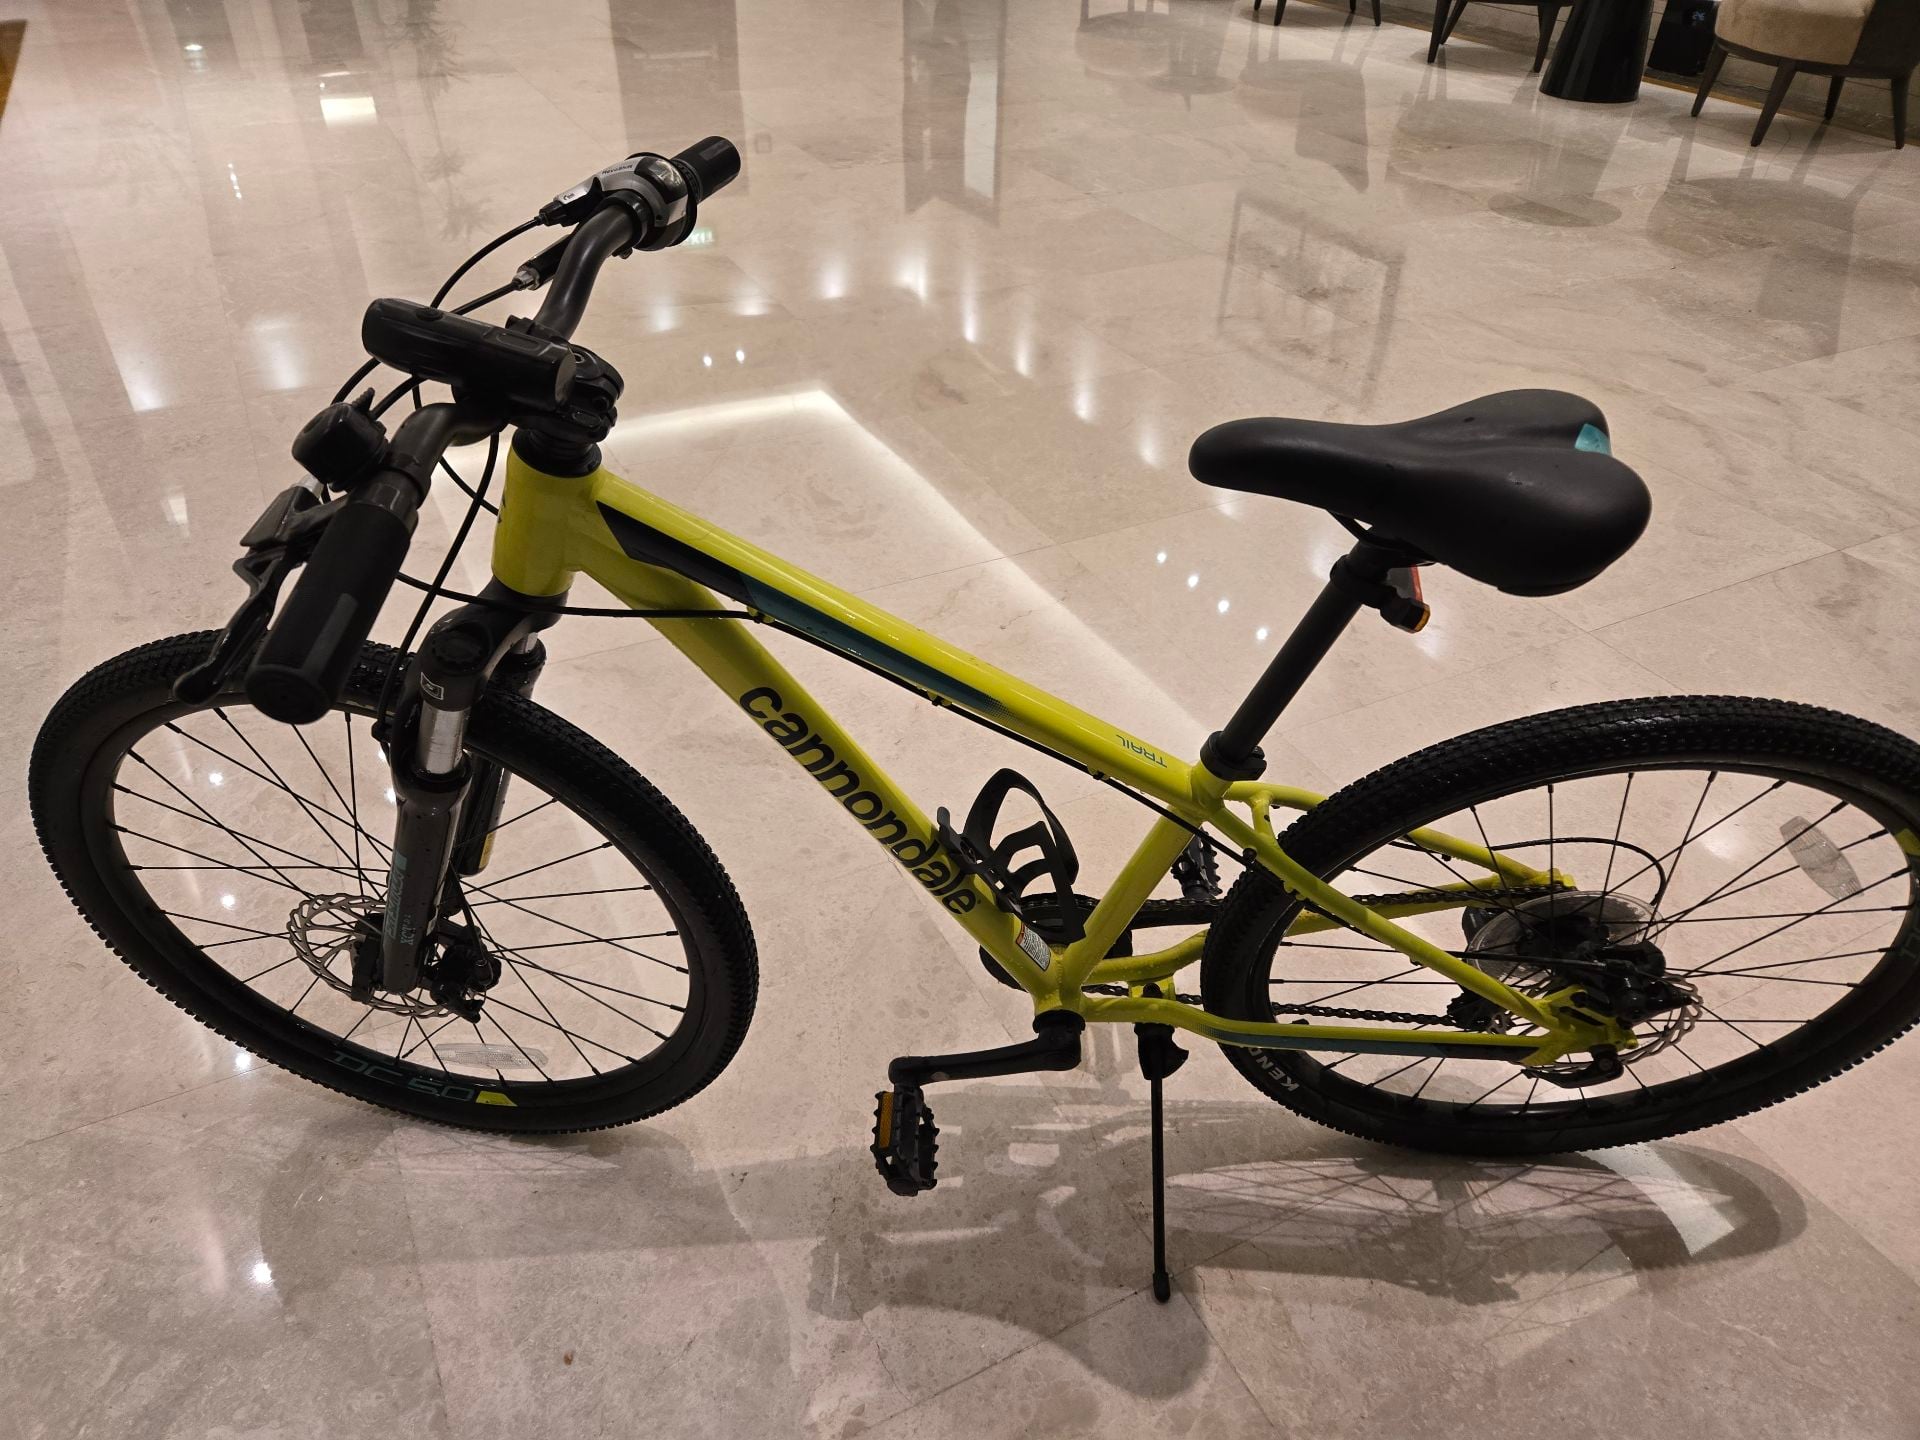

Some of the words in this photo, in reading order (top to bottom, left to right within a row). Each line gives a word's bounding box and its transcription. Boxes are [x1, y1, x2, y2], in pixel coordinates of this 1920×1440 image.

[1116, 734, 1168, 768] TRAIL
[739, 686, 976, 915] cannondale
[1247, 1046, 1300, 1092] KEND
